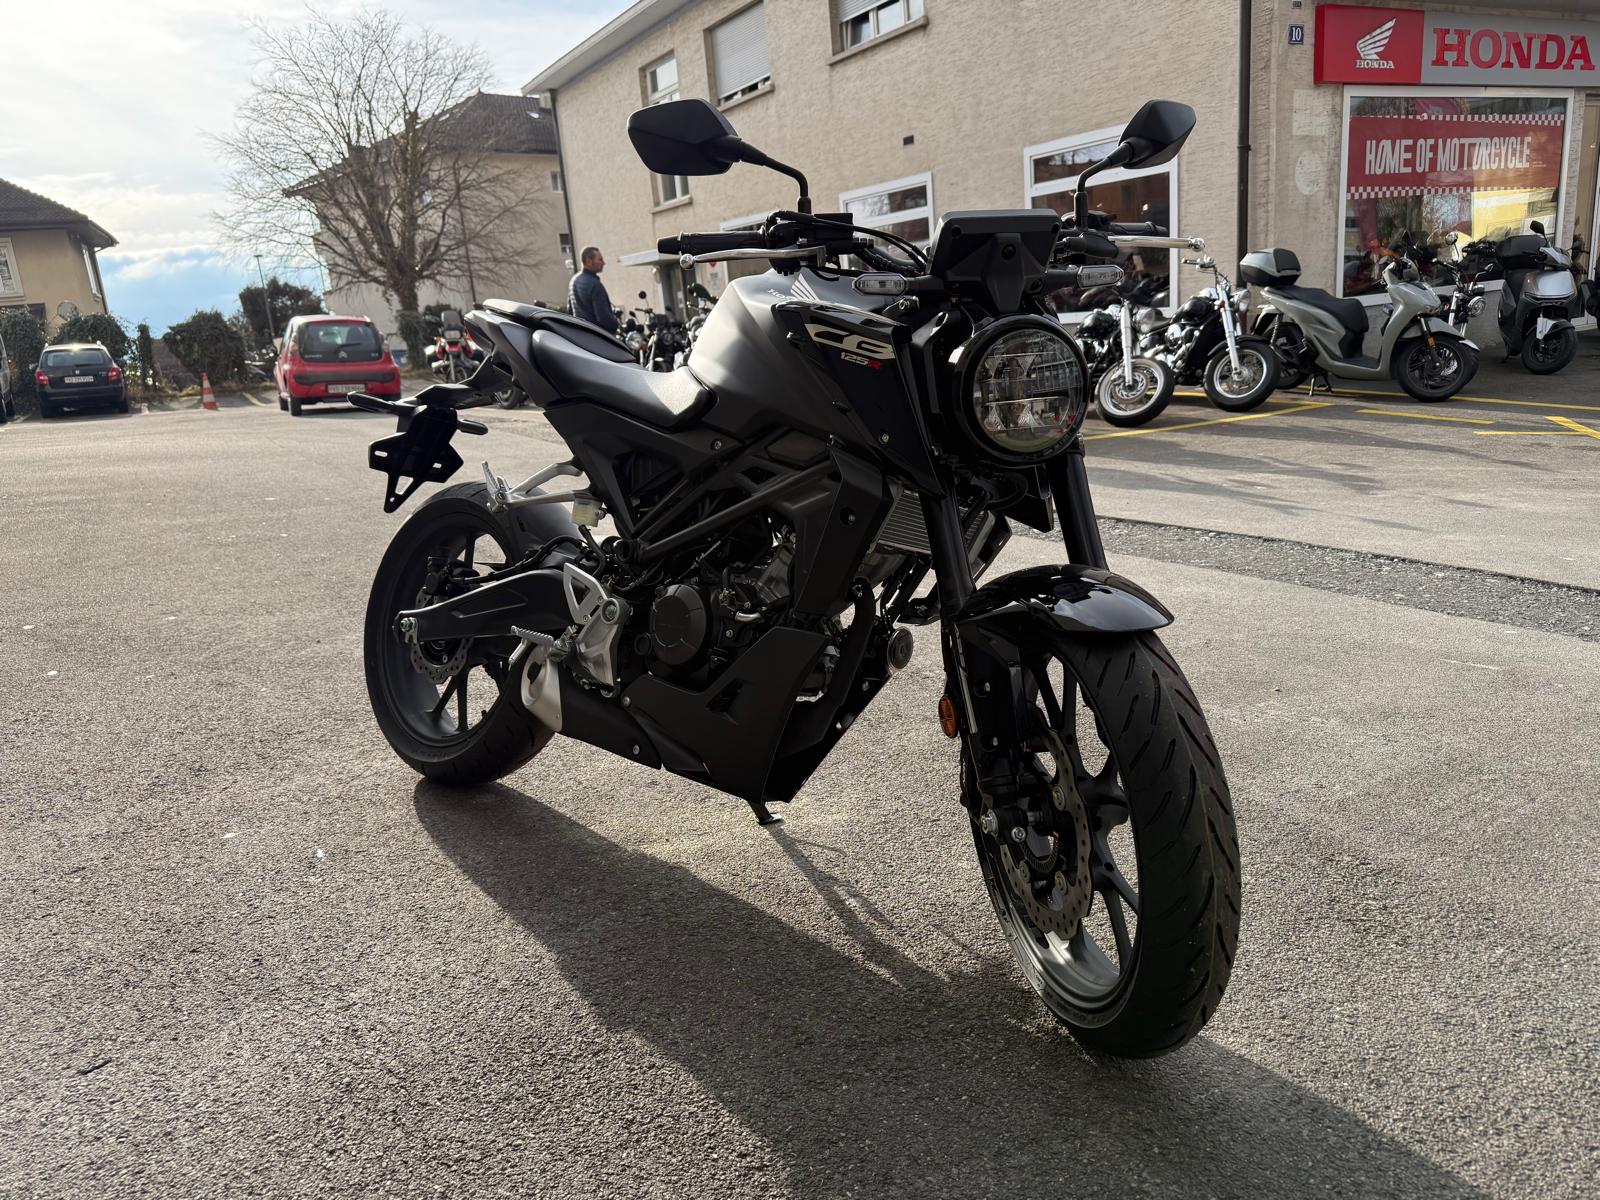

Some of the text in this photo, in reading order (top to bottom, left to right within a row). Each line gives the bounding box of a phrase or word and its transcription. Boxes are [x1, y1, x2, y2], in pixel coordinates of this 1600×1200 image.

[1291, 27, 1302, 41] 10
[1431, 27, 1596, 71] HONDA
[1355, 59, 1395, 69] HONDA
[1364, 136, 1532, 175] HOME OF MOTORCYCLE
[804, 323, 896, 360] CB
[840, 351, 881, 370] 125R
